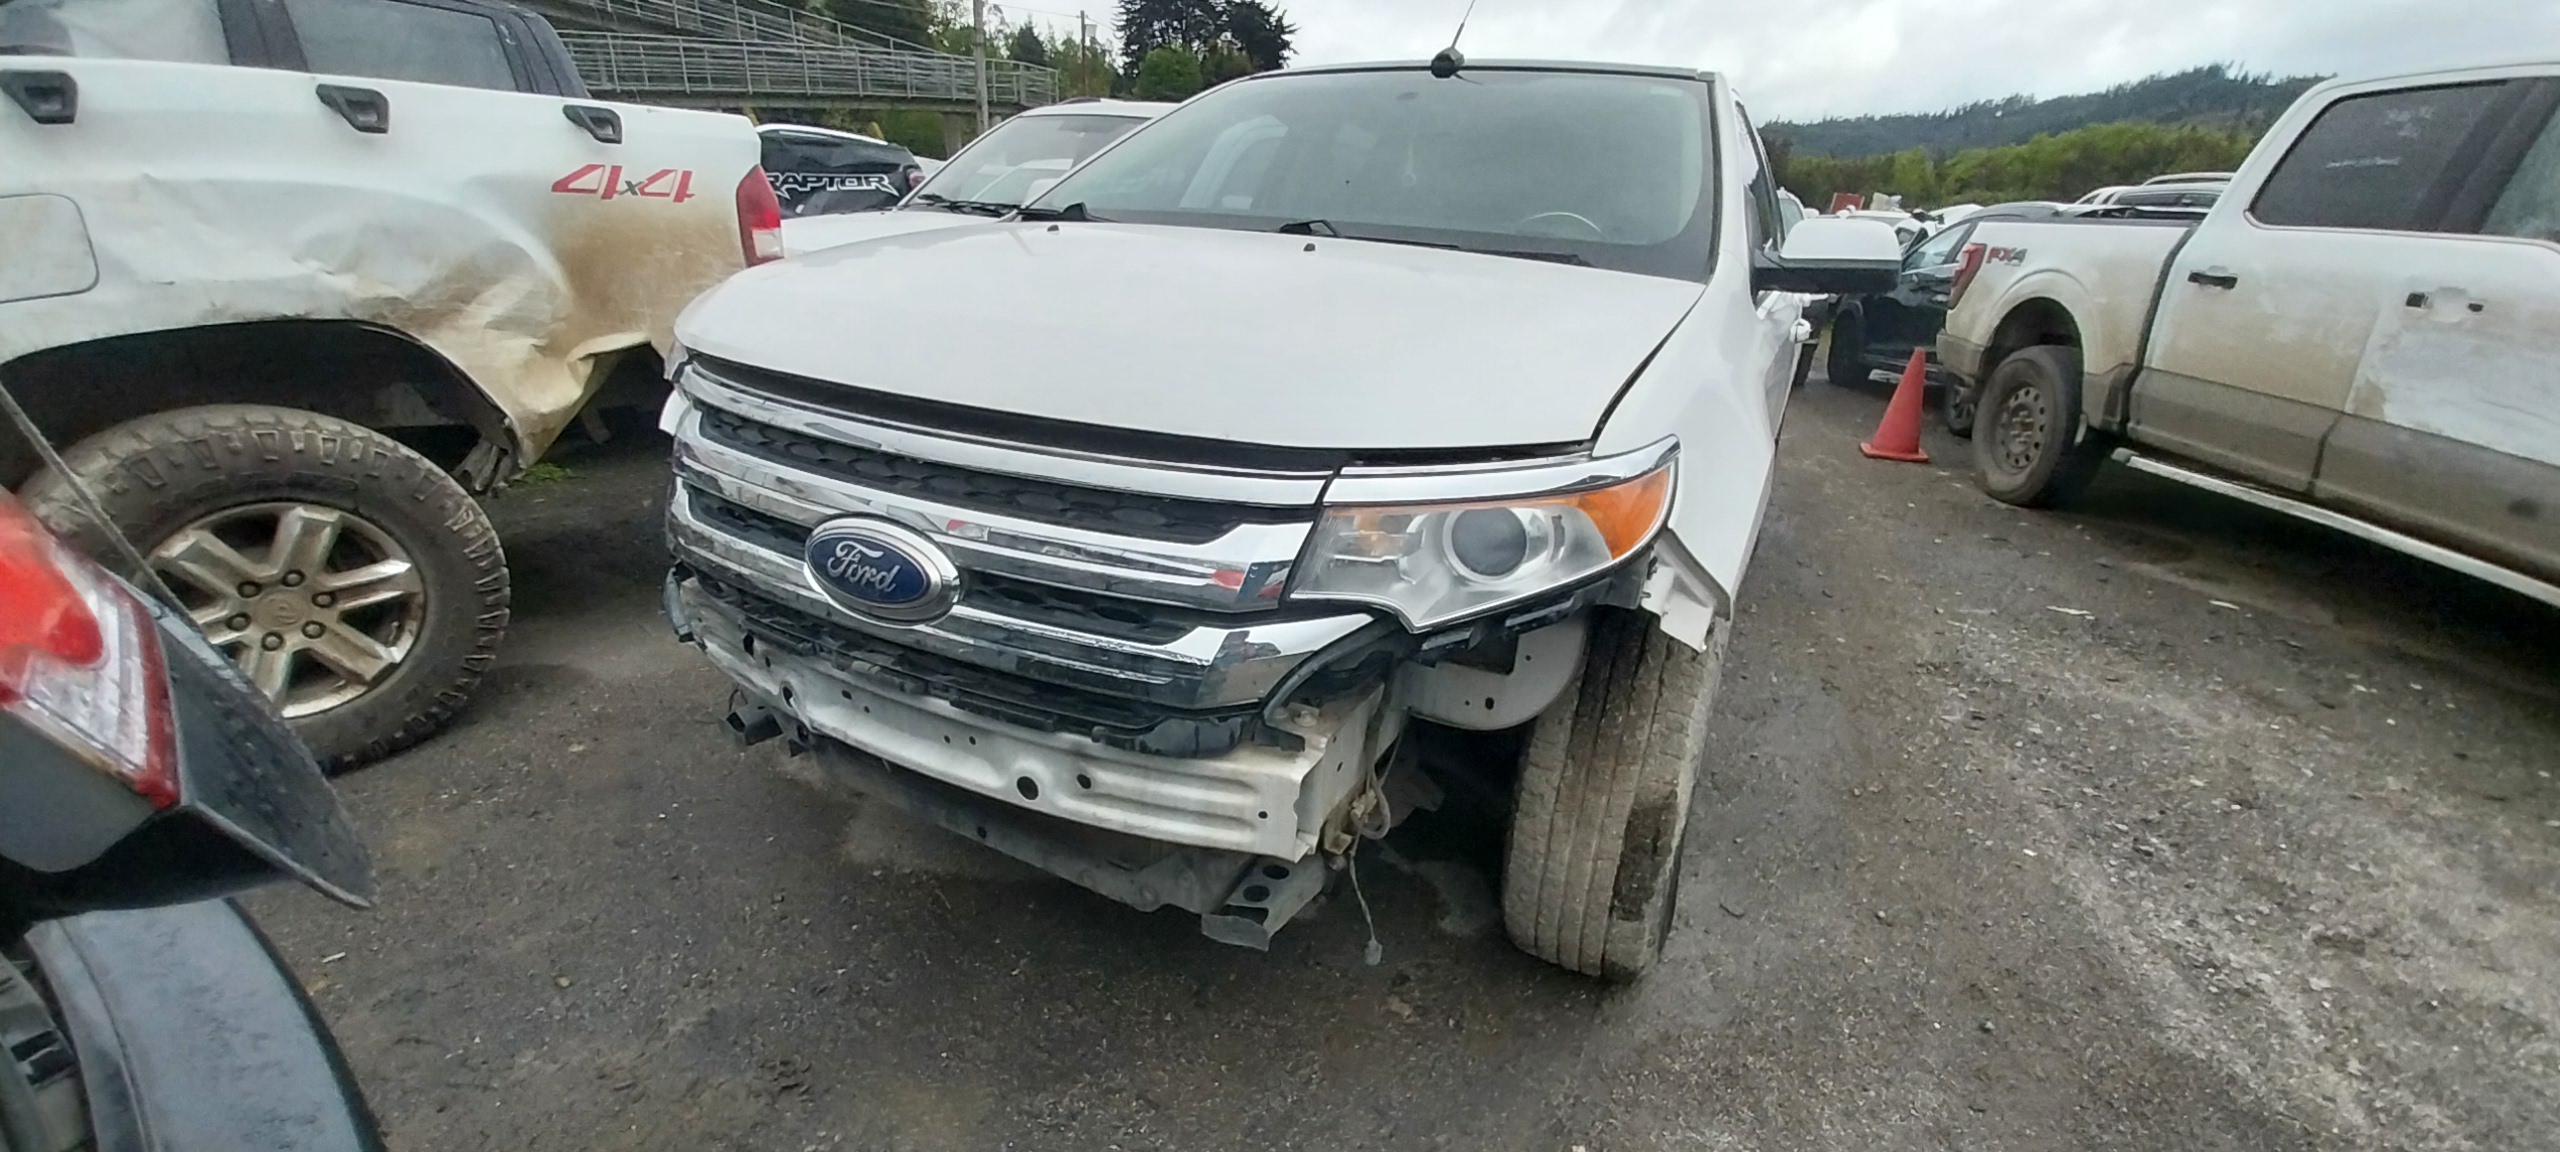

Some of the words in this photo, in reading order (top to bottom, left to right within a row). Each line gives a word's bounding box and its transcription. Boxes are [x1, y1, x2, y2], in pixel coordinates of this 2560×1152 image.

[766, 172, 900, 200] RAPTOR
[1986, 246, 2028, 264] FX4
[827, 540, 901, 592] Ford
